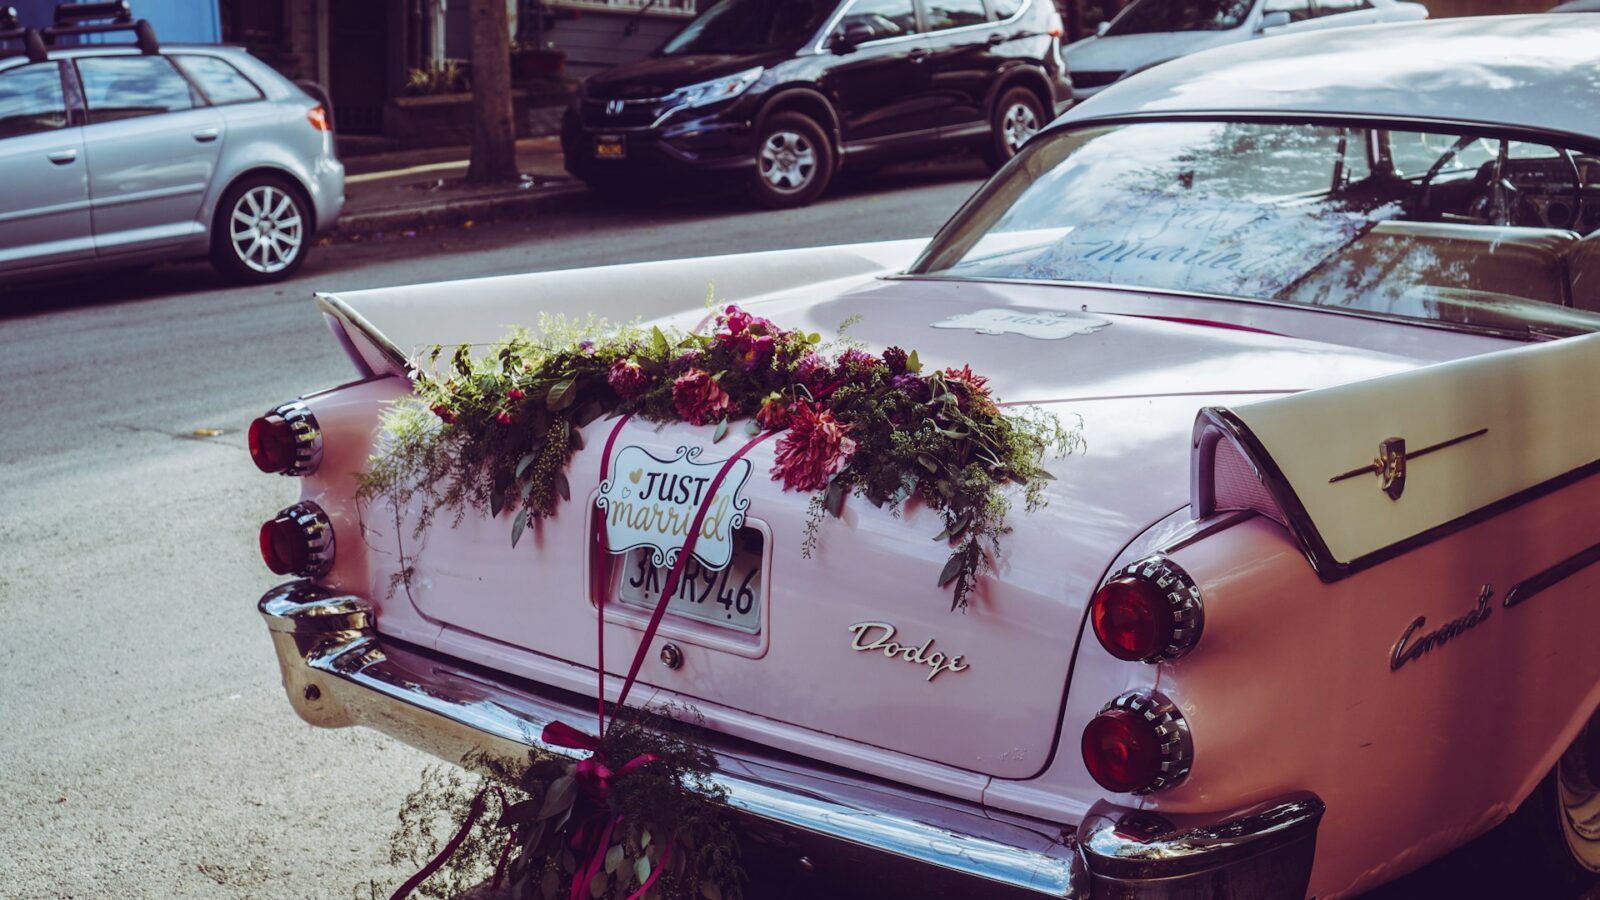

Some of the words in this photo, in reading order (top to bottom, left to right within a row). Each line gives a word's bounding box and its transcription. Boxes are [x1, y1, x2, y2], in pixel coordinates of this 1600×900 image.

[639, 472, 710, 506] JUST
[612, 495, 730, 542] marrid
[630, 550, 760, 614] 3KR946
[848, 621, 970, 681] Dodge
